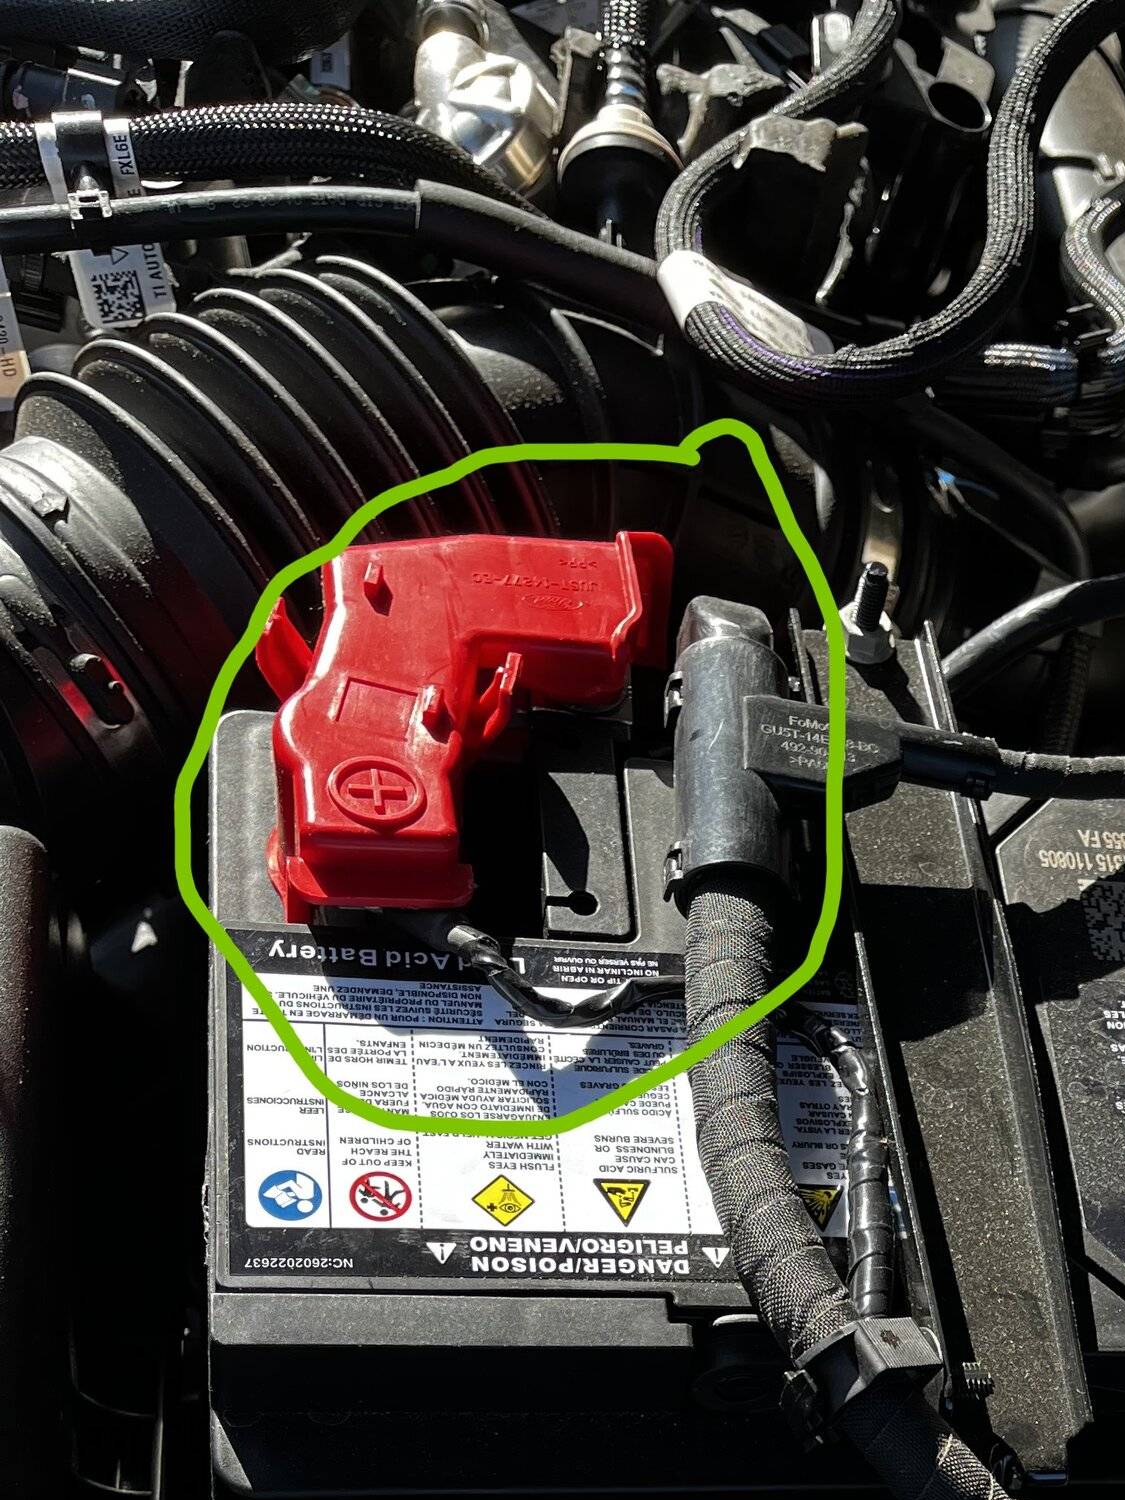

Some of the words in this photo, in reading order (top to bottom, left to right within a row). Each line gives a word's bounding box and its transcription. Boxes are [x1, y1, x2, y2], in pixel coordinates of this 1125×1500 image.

[114, 134, 136, 176] FXL6E
[1077, 829, 1101, 847] FA
[1038, 849, 1093, 870] 110805
[268, 939, 377, 966] Battery
[386, 951, 449, 970] Acid
[552, 965, 584, 973] ABRIR
[597, 968, 643, 976] INCLINAR
[561, 975, 588, 983] OPEN
[590, 976, 605, 984] OR
[313, 984, 333, 993] UNE
[337, 986, 393, 996] DEMANDEZ
[419, 982, 481, 992] ASSISTANCE
[333, 994, 347, 1003] DU
[455, 992, 482, 1000] NON
[279, 1000, 293, 1008] DU
[296, 1001, 371, 1012] INSTRUCTIONS
[425, 999, 439, 1007] DU
[442, 999, 482, 1009] MANUEL
[290, 1009, 303, 1017] EN
[373, 1005, 393, 1013] LES
[375, 1013, 388, 1021] UN
[391, 1014, 419, 1022] POUR
[1103, 1010, 1125, 1019] LES
[428, 1016, 483, 1025] ATTENTION
[356, 1039, 406, 1048] ENFANTS.
[350, 1048, 391, 1057] PORTÉE
[485, 1044, 545, 1053] CONSULTEZ
[604, 1057, 640, 1065] CAUSER
[507, 1062, 546, 1070] RINCEZ
[574, 1065, 629, 1073] SULFURIQUE
[336, 1080, 368, 1089] NIÑOS
[579, 1081, 619, 1089] GRAVES
[247, 1097, 325, 1105] INSTRUCCIONES
[497, 1096, 549, 1104] SOLICITAR
[639, 1100, 671, 1108] PUEDE
[456, 1103, 478, 1111] CON
[480, 1103, 534, 1112] INMEDIATO
[430, 1110, 458, 1118] OJOS
[460, 1111, 480, 1119] LOS
[247, 1138, 326, 1146] INSTRUCTIONS
[339, 1137, 395, 1145] CHILDREN
[396, 1138, 411, 1146] OF
[594, 1135, 630, 1143] BURNS
[633, 1136, 674, 1145] SEVERE
[486, 1141, 524, 1150] WATER
[526, 1142, 553, 1150] WITH
[594, 1145, 610, 1153] OR
[350, 1148, 388, 1156] REACH
[390, 1148, 411, 1156] THE
[615, 1146, 674, 1154] BLINDNESS
[483, 1151, 554, 1160] IMMEDIATELY
[615, 1155, 651, 1163] CAUSE
[342, 1158, 357, 1166] OF
[384, 1159, 412, 1167] KEEP
[652, 1156, 675, 1164] CAN
[488, 1161, 516, 1170] EYES
[519, 1162, 554, 1171] FLUSH
[599, 1165, 625, 1173] ACID
[626, 1166, 678, 1174] SULFURIC
[470, 1236, 688, 1254] PELIGRO/VENENO
[244, 1257, 354, 1268] NC:2602022637
[471, 1256, 690, 1274] DANGER/POISON
